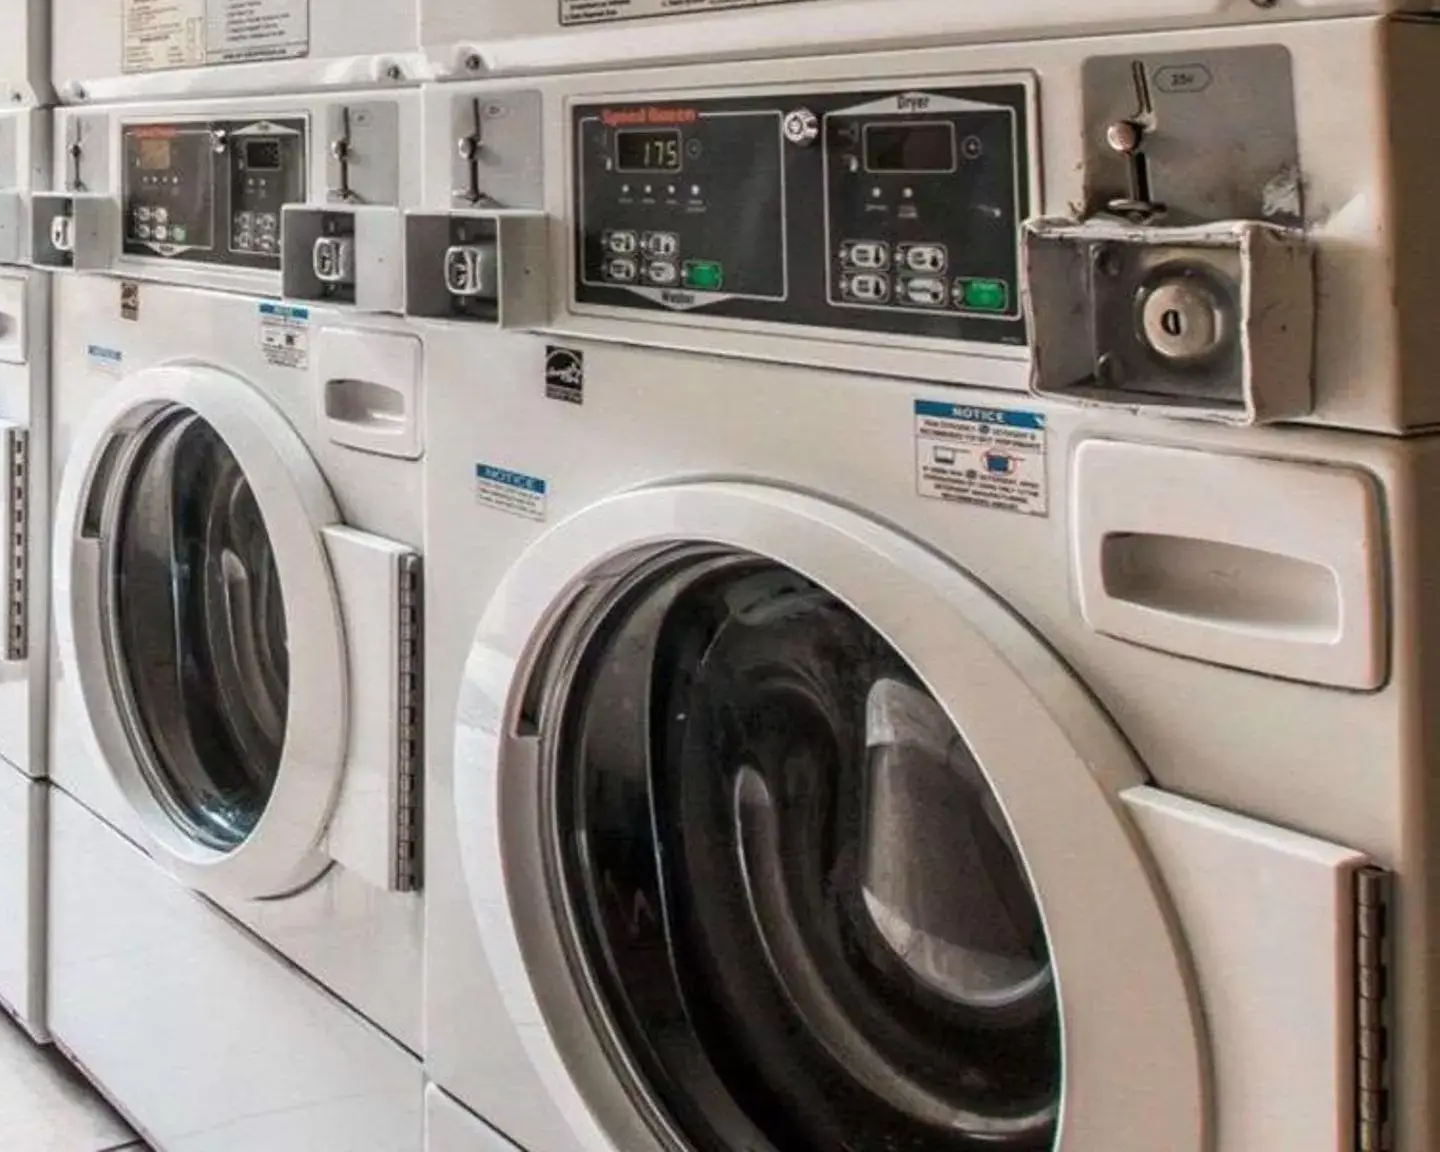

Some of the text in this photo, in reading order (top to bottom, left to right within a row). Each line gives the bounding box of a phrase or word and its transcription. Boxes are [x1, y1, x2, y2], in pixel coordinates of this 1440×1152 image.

[897, 96, 930, 112] Dryer
[643, 139, 677, 167] 175
[951, 407, 1005, 423] NOTICE
